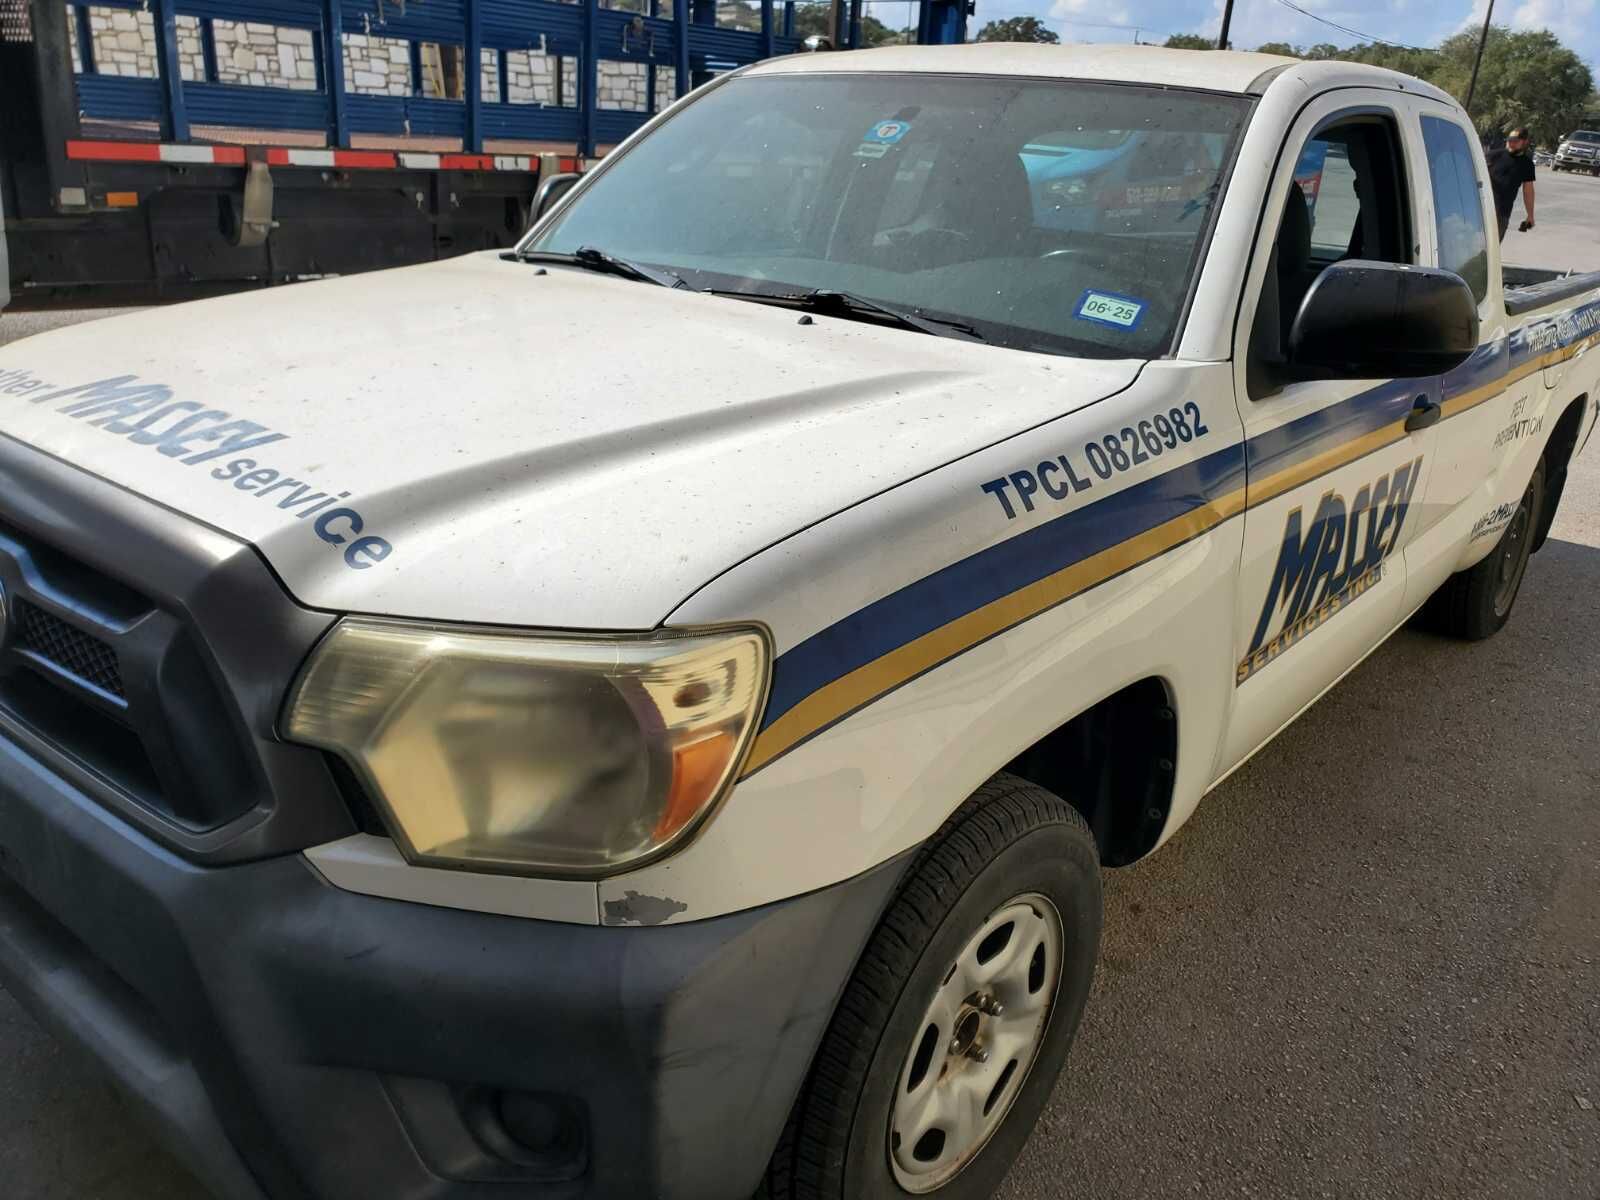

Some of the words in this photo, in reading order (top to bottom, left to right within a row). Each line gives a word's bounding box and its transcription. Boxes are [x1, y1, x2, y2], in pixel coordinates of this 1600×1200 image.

[1087, 300, 1107, 314] 06
[1112, 306, 1134, 320] 25
[28, 374, 290, 466] MASSEY
[210, 457, 393, 570] service
[980, 454, 1093, 520] TPCL
[1084, 401, 1209, 481] 0826982
[1246, 454, 1425, 657] MASSEY
[1237, 594, 1342, 682] SERVICES
